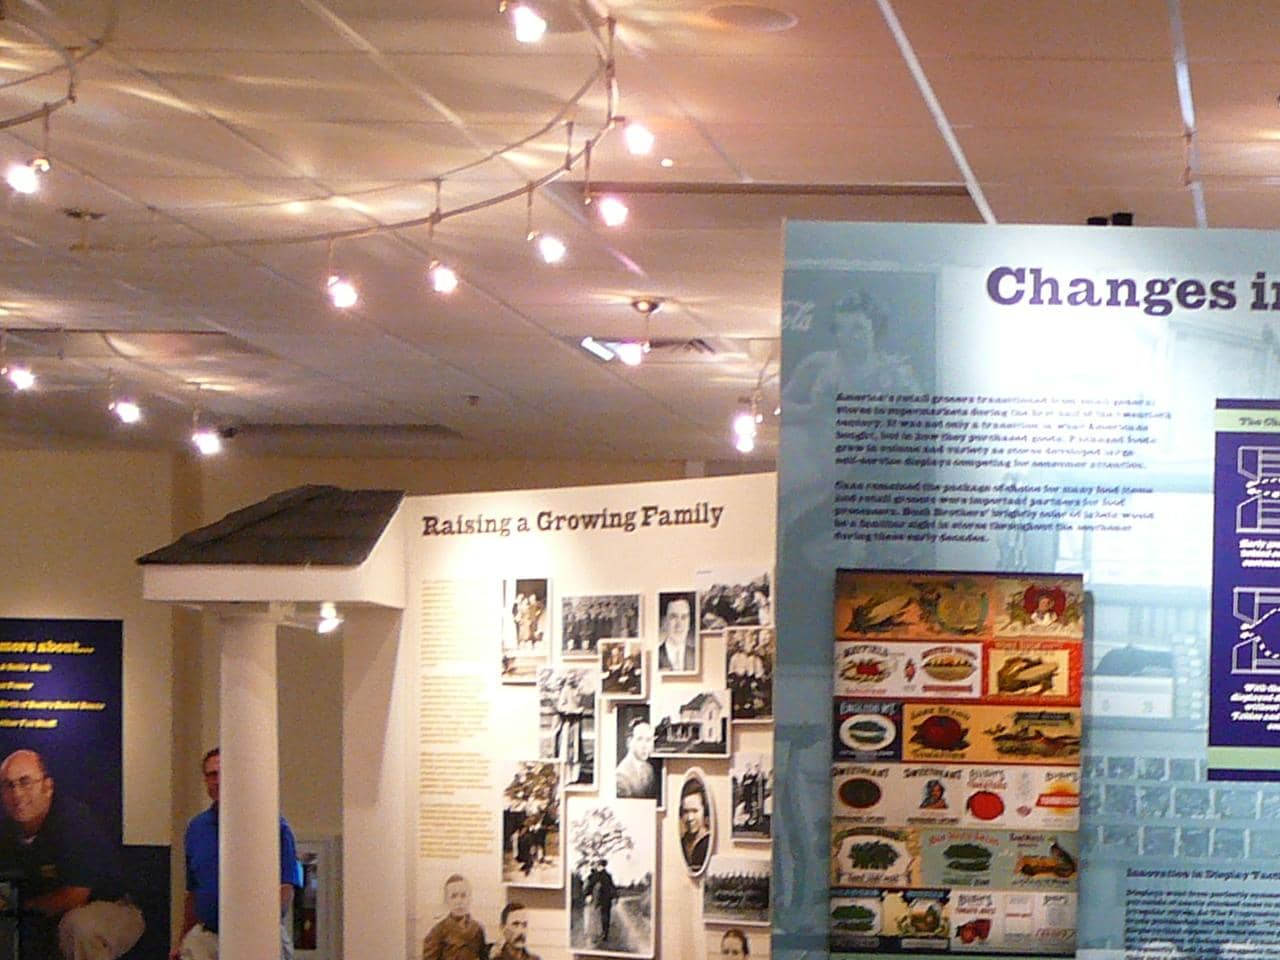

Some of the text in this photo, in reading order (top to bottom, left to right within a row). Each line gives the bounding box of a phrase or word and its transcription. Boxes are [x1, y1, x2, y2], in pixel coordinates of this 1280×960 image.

[986, 265, 1237, 316] Changes
[422, 502, 725, 537] Raising a Growing Family
[1205, 869, 1249, 881] Display
